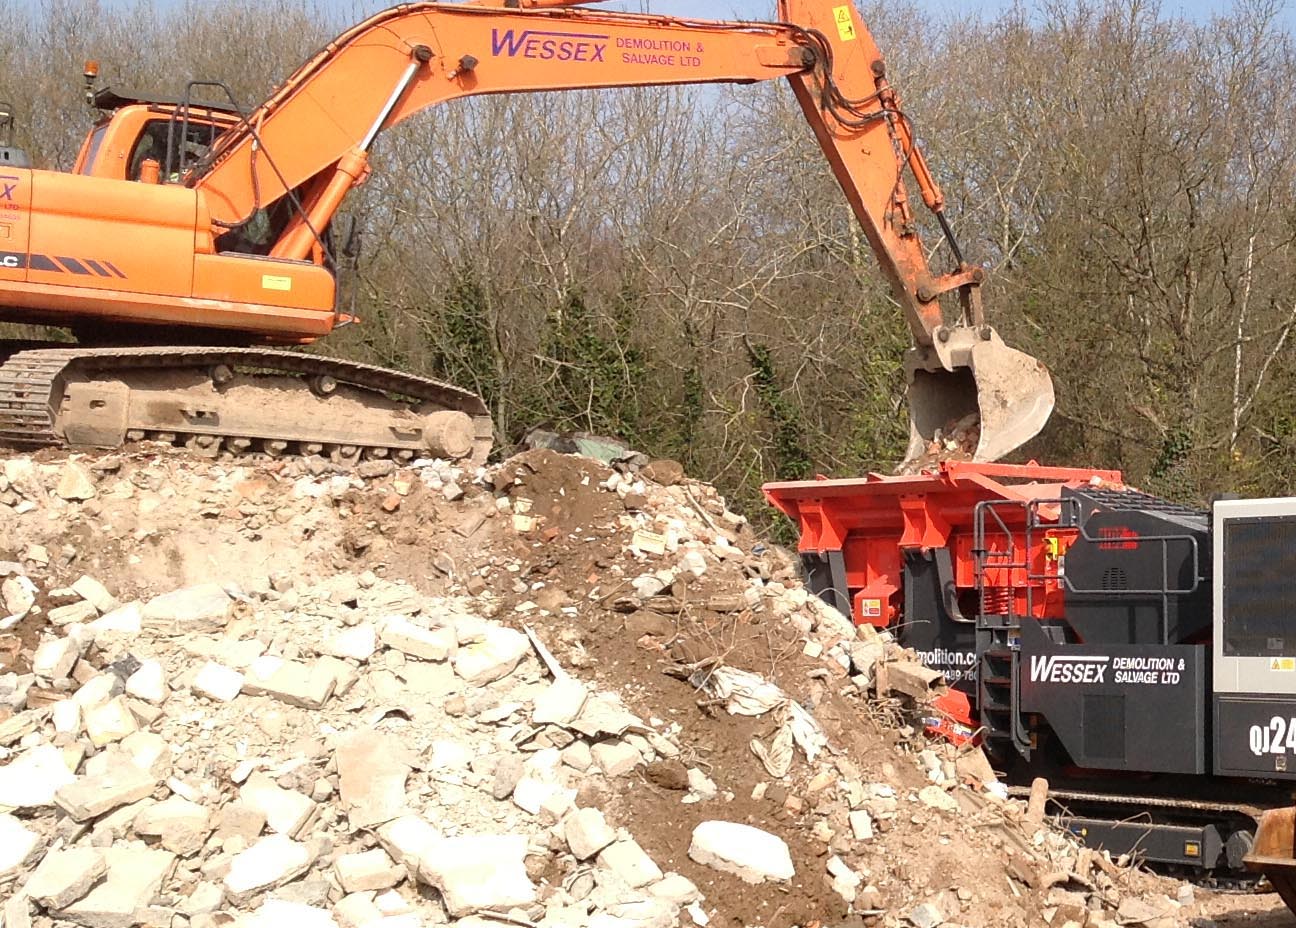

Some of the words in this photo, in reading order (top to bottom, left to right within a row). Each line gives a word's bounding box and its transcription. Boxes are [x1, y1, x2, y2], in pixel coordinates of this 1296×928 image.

[492, 28, 609, 62] WESSEX
[616, 37, 690, 52] DEMOLITION
[696, 42, 704, 53] &
[622, 52, 675, 66] SALVAGE
[680, 55, 700, 67] LTD
[1030, 655, 1110, 683] WESSEX
[1112, 657, 1174, 670] DEMOLITION
[1177, 658, 1185, 671] &
[1114, 671, 1158, 684] SALVAGE
[1161, 672, 1180, 684] LTD
